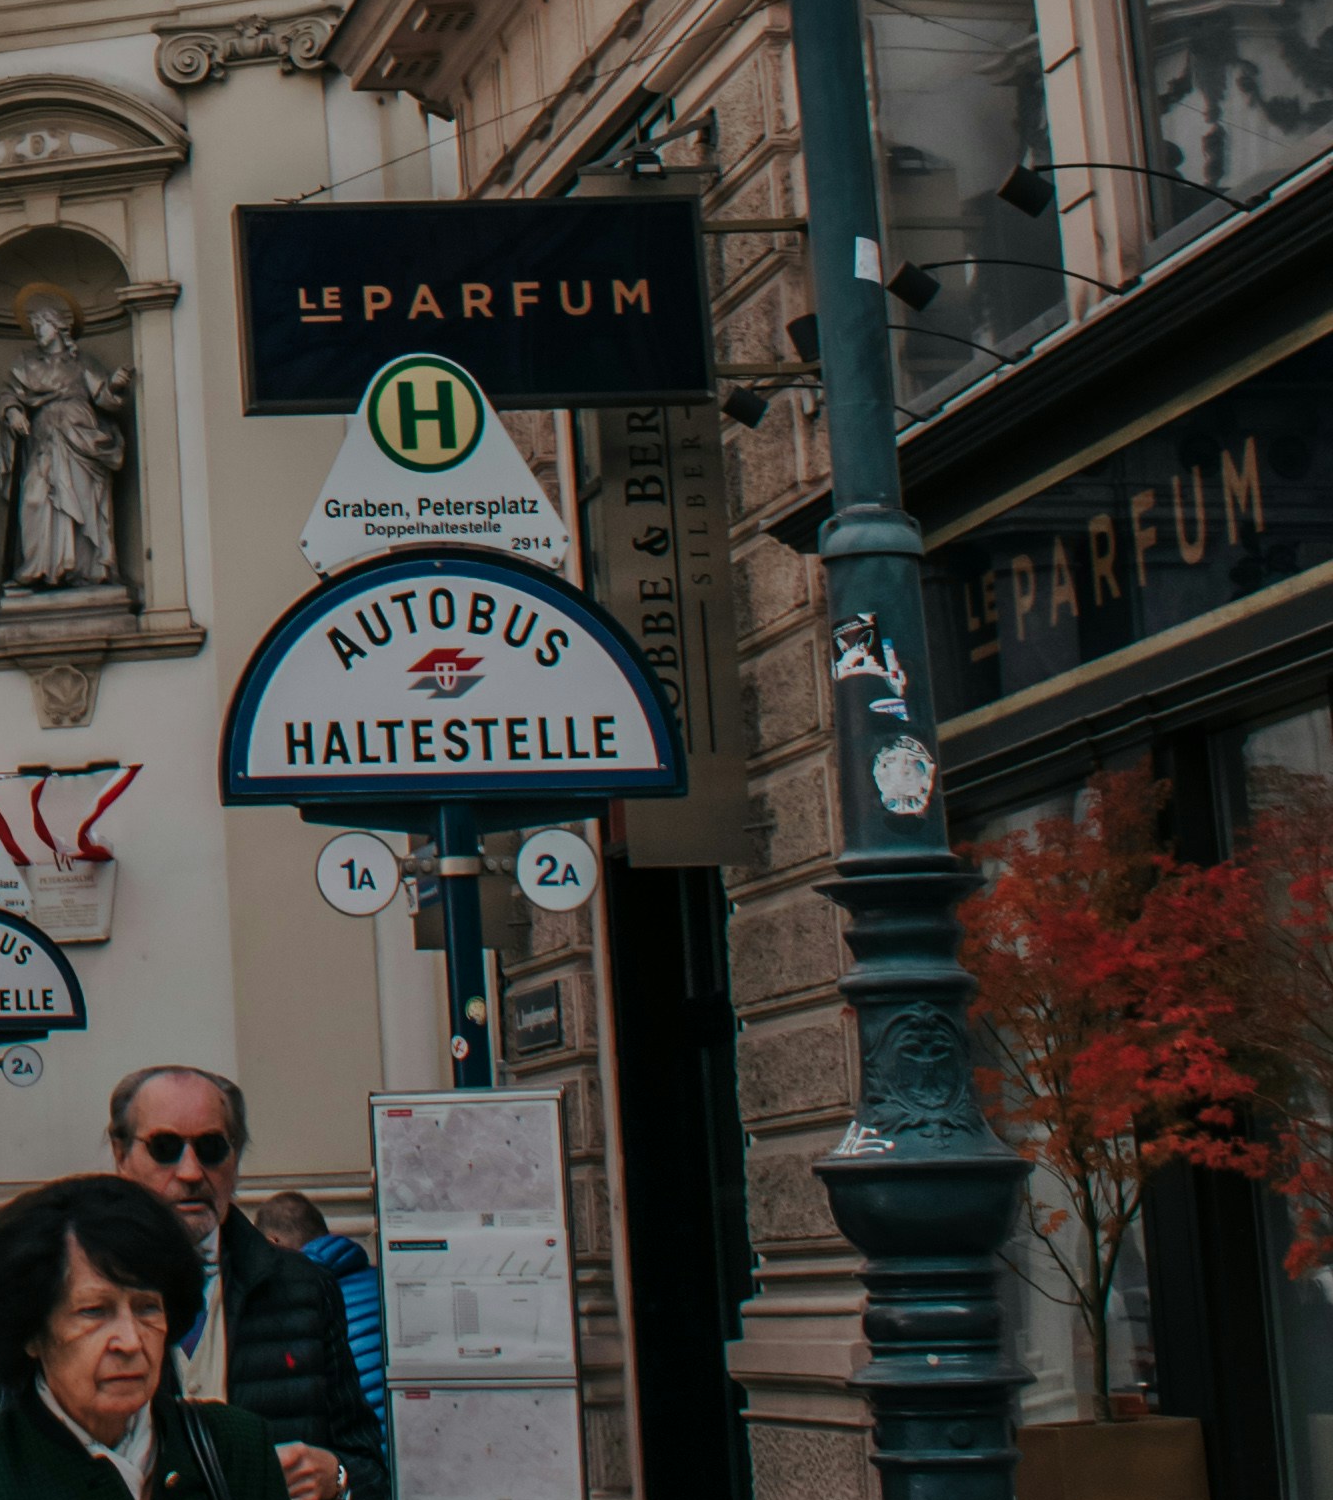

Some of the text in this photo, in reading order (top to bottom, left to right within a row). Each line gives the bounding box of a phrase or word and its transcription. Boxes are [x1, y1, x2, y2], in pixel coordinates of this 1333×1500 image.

[297, 278, 652, 322] LE PARFUM
[397, 379, 460, 451] H
[323, 494, 539, 523] Graben, Petersplatz
[682, 434, 714, 586] SILBER
[363, 520, 502, 539] Doppelhaltestelle
[511, 535, 553, 552] 2914
[633, 525, 670, 558] &
[1012, 435, 1266, 643] PARFUM
[324, 587, 571, 672] AUTOBUS
[639, 576, 684, 735] OBBE
[285, 714, 619, 766] HALTESTELLE
[340, 858, 378, 891] 1A
[535, 853, 581, 887] 2A
[10, 1055, 36, 1077] 2A
